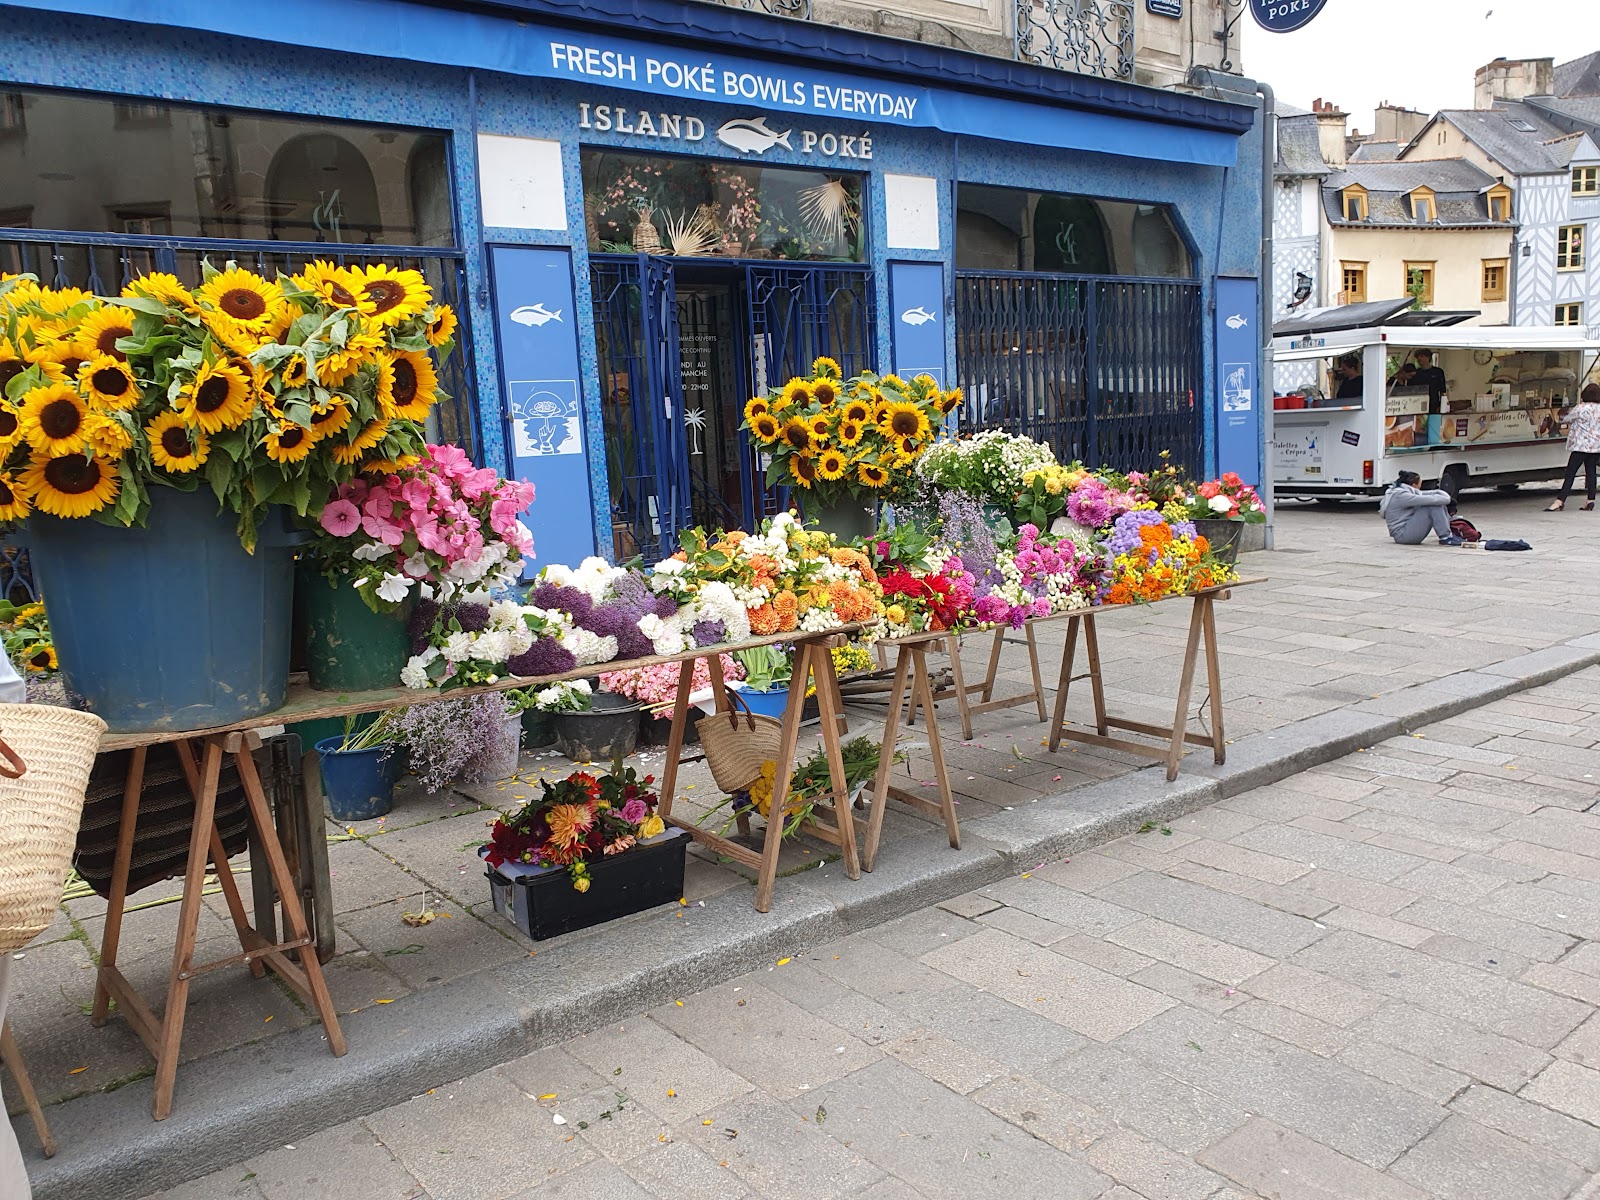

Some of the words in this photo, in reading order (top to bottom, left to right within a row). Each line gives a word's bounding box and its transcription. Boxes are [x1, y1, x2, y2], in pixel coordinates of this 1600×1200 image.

[550, 42, 637, 82] FRESH
[645, 58, 717, 94] POKÉ
[723, 71, 806, 106] BOWLS
[813, 84, 917, 120] EVERYDAY
[578, 102, 706, 141] ISLAND
[801, 130, 874, 160] POKÉ
